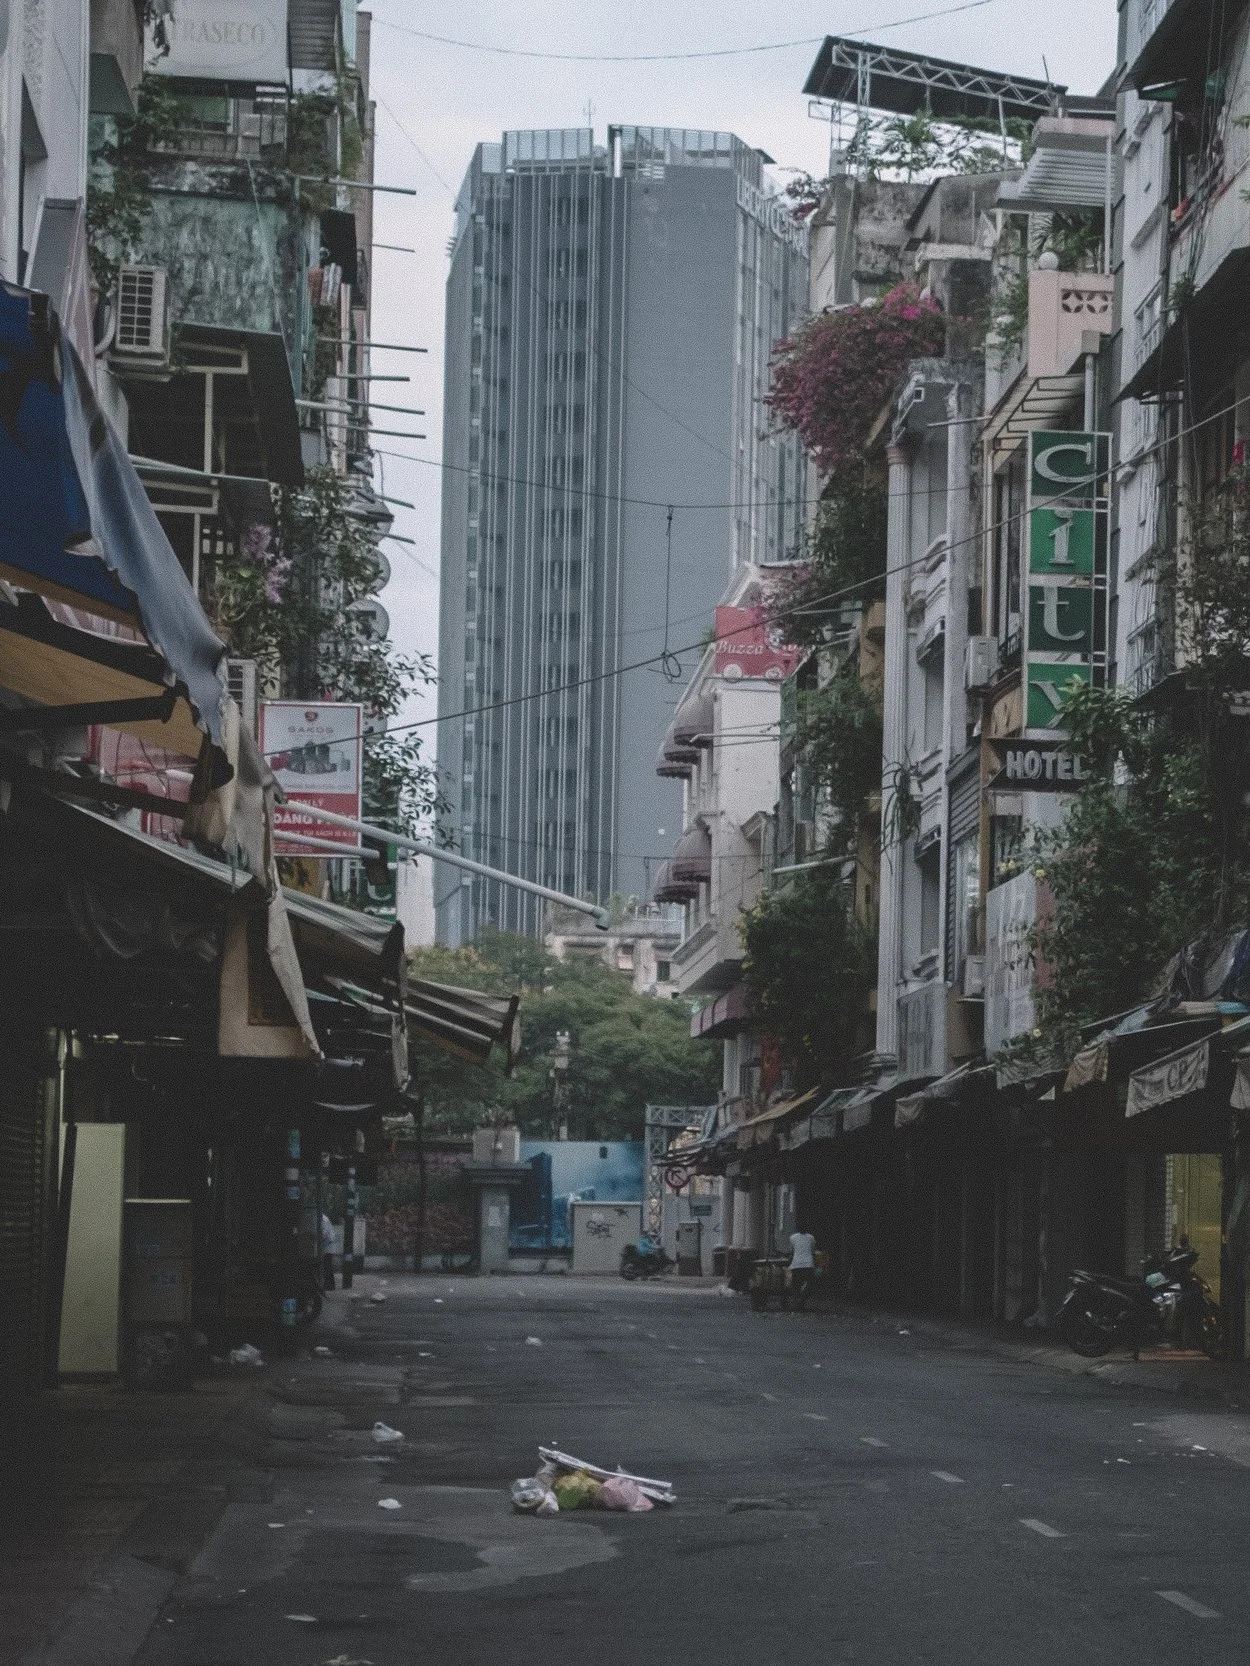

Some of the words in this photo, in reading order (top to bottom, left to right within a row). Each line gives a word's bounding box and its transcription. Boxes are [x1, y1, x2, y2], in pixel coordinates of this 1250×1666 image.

[715, 639, 764, 655] Buzza
[287, 725, 334, 733] SAKOS
[1005, 750, 1090, 781] HOTEL
